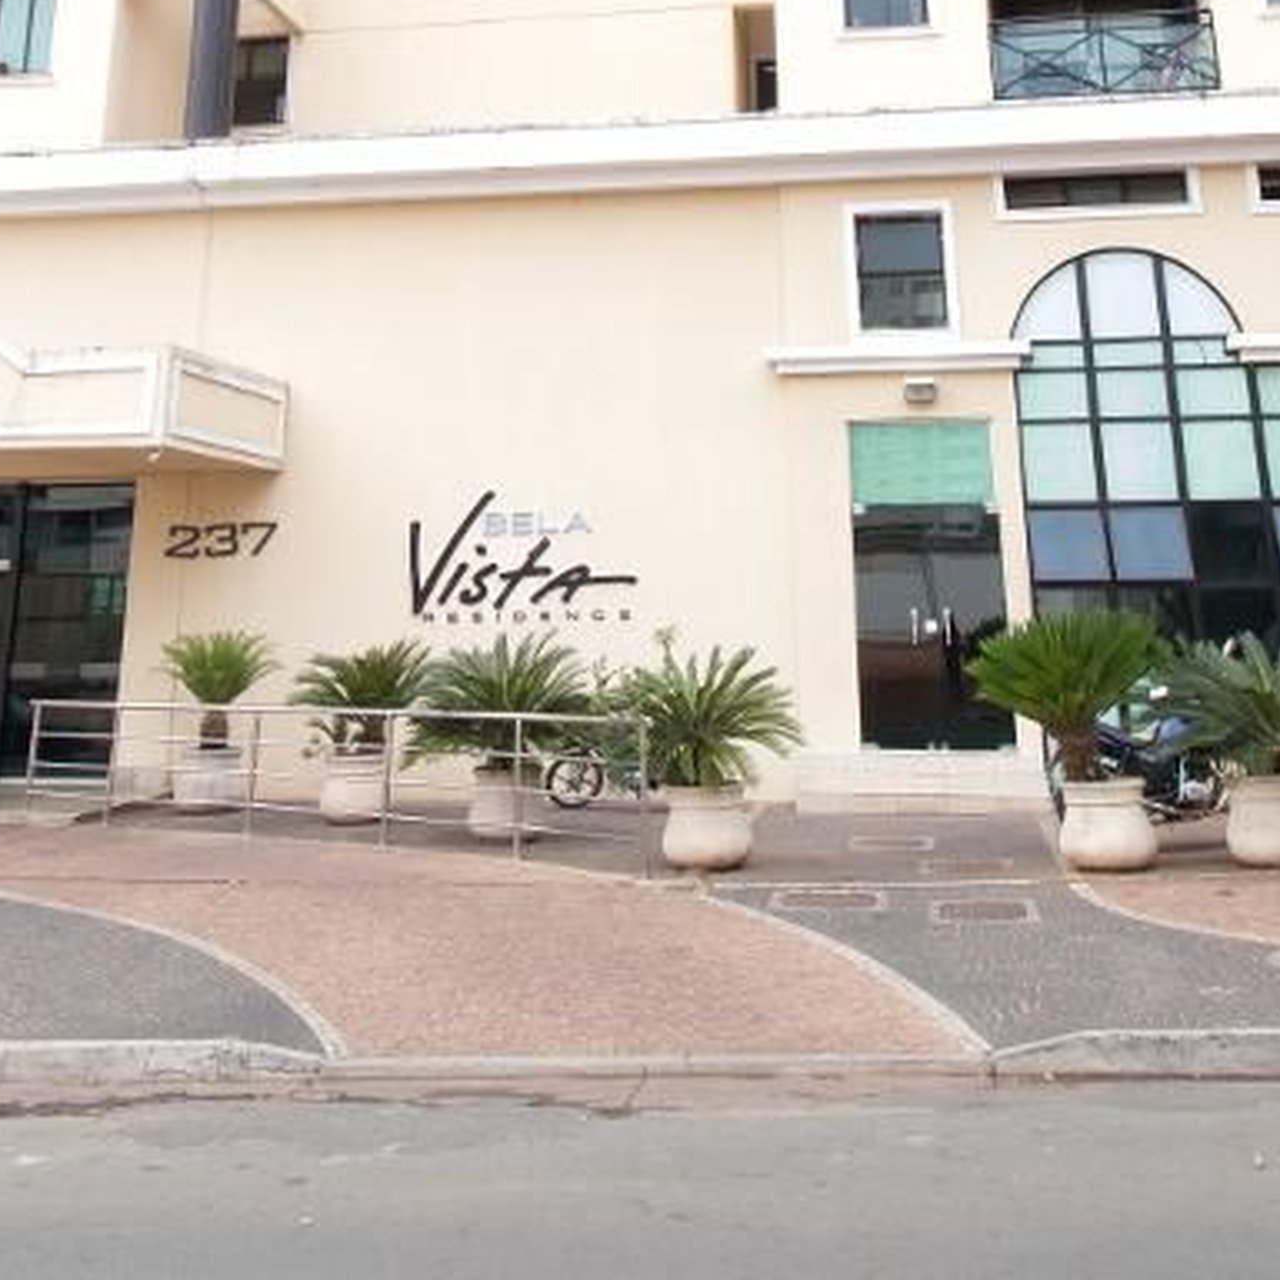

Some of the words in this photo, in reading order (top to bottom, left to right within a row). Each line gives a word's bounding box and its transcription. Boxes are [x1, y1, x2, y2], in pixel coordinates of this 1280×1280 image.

[482, 513, 592, 536] BELA
[164, 522, 277, 559] 237
[410, 490, 637, 615] Vista
[422, 609, 632, 624] RESIDENCE
